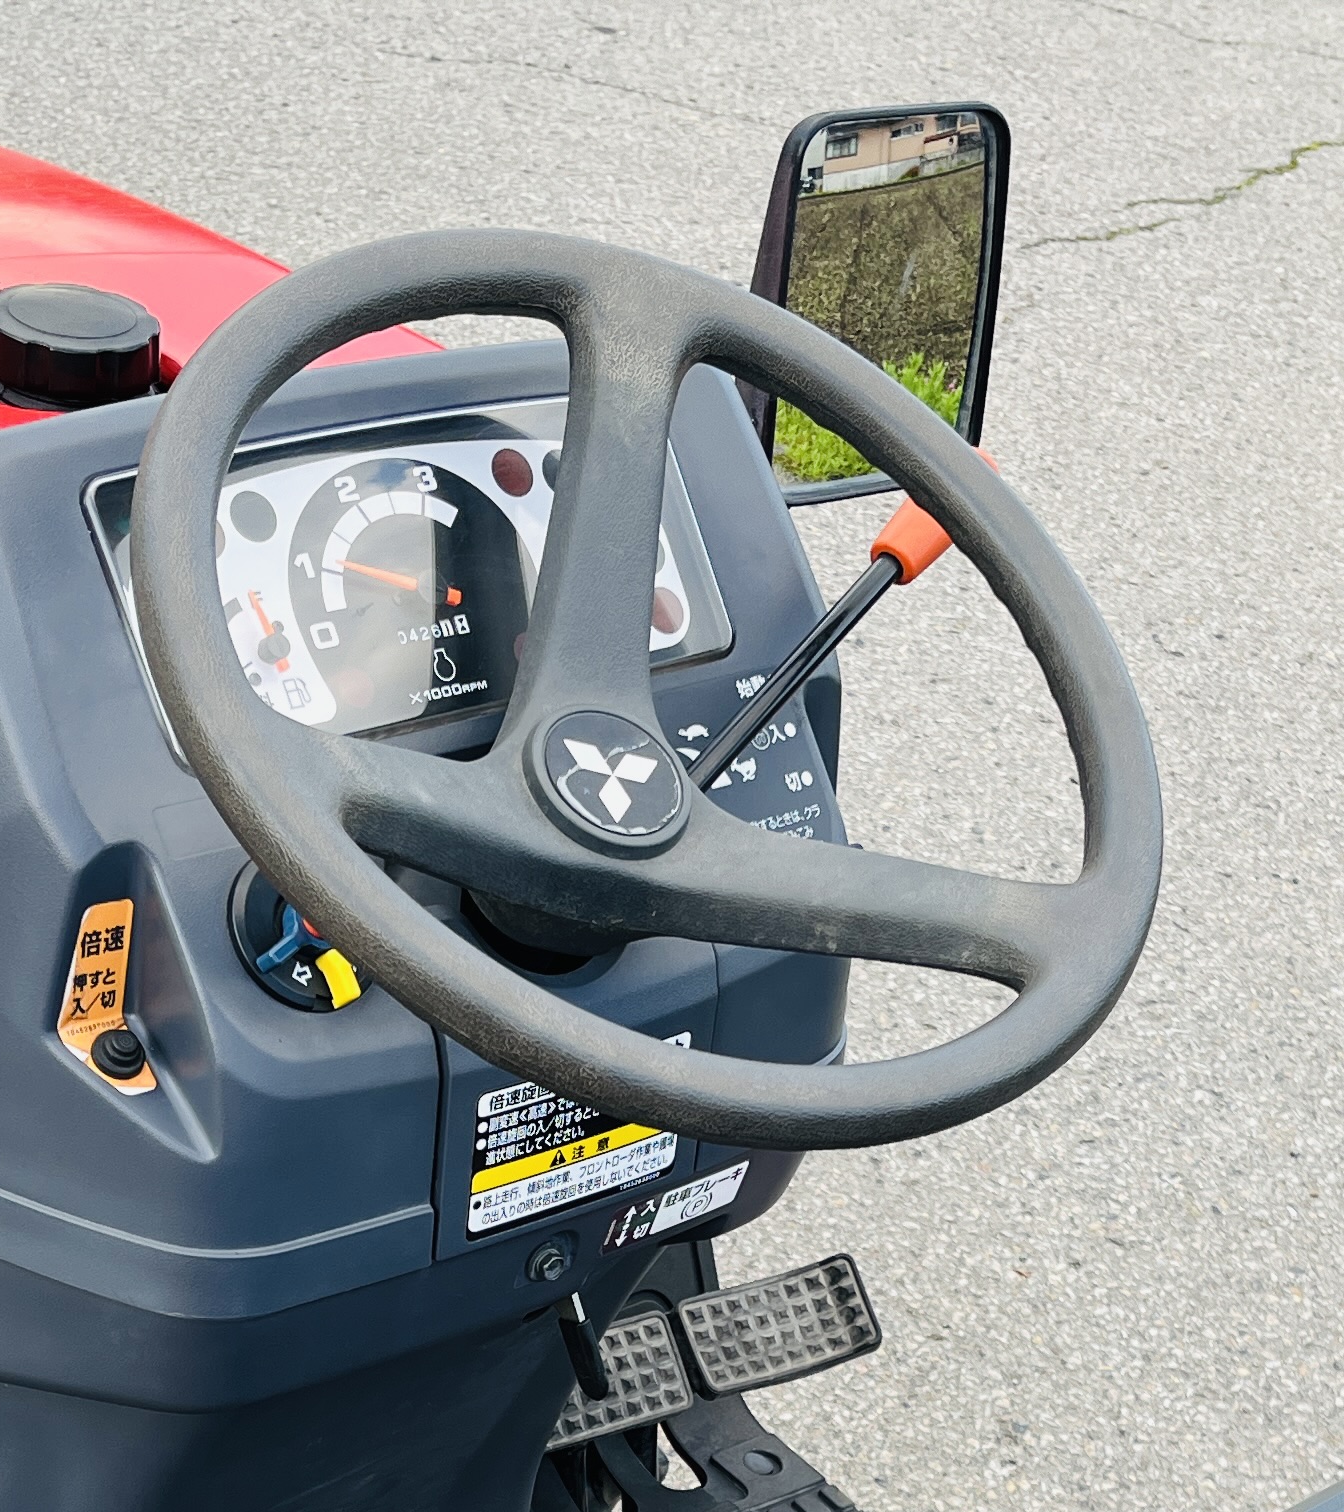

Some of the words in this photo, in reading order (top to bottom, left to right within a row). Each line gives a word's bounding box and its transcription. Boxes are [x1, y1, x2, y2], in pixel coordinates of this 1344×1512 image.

[335, 476, 360, 502] 2
[413, 466, 437, 494] 3
[294, 553, 315, 579] 1
[310, 621, 340, 649] 0
[769, 724, 786, 744] 入
[785, 771, 802, 792] 切
[81, 925, 126, 958] 倍速
[73, 969, 116, 993] 押すと
[571, 1137, 609, 1160] 注意
[663, 1167, 743, 1207] 駐車ブレーキ
[633, 1222, 651, 1240] 切
